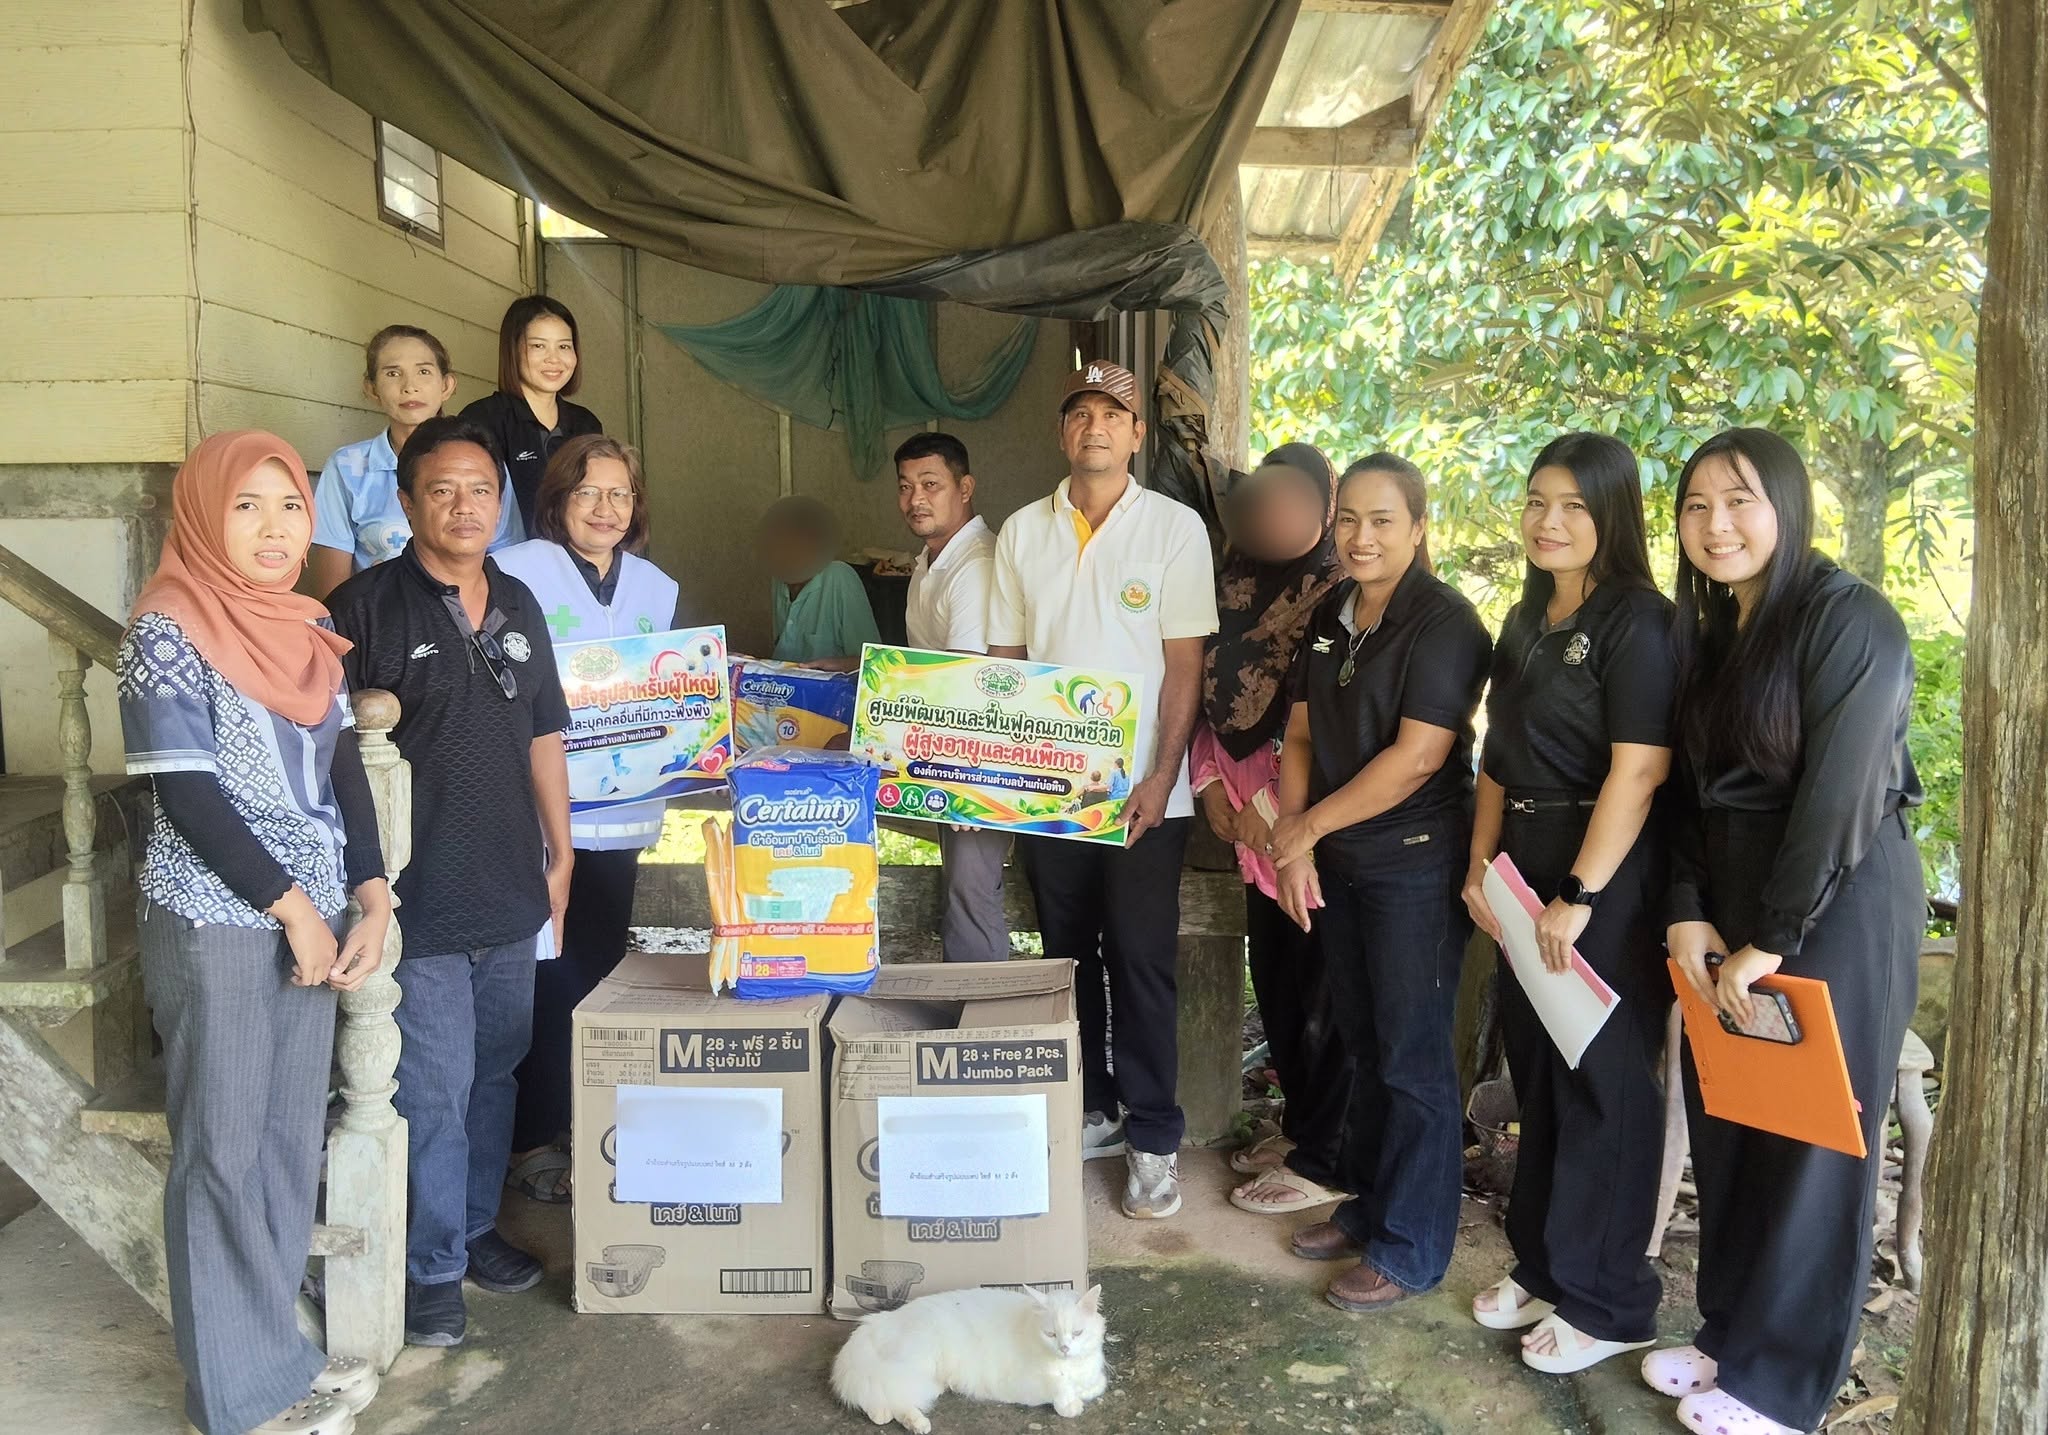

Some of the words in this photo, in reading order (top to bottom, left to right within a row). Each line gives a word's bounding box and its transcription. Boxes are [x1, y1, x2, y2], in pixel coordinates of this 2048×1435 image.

[1085, 365, 1104, 383] LA
[565, 672, 717, 708] ำเร็จรูปสำหรับผู้ใหญ่
[742, 681, 793, 698] Certainty
[561, 702, 711, 736] ุและบุคคลอื่นที่มีภาวะพึ่งพิง
[869, 696, 1121, 744] ศูนย์พัฒนาและฟื้นฟูคุณภาพชีวิต
[563, 728, 661, 751] บริหารส่วนตำบลป่าแก่บ่อหิน
[782, 725, 795, 736] 10
[905, 725, 1085, 769] ผู้สูงอายุและคนพิการ
[740, 797, 857, 826] Certainty
[741, 963, 752, 976] M
[755, 963, 769, 976] 28
[667, 1034, 702, 1068] M
[705, 1038, 725, 1051] 28
[729, 1040, 738, 1050] +
[743, 1035, 764, 1050] ฟรี
[768, 1038, 778, 1050] 2
[781, 1032, 802, 1050] ชิ้น
[705, 1052, 761, 1072] รุ่นจัมโบ้
[921, 1047, 958, 1080] M
[962, 1049, 978, 1062] 28
[982, 1051, 990, 1061] +
[993, 1048, 1022, 1061] Free
[1025, 1047, 1033, 1060] 2
[1036, 1046, 1064, 1059] Pcs.
[962, 1066, 1013, 1079] Jumbo
[1017, 1064, 1053, 1078] Pack
